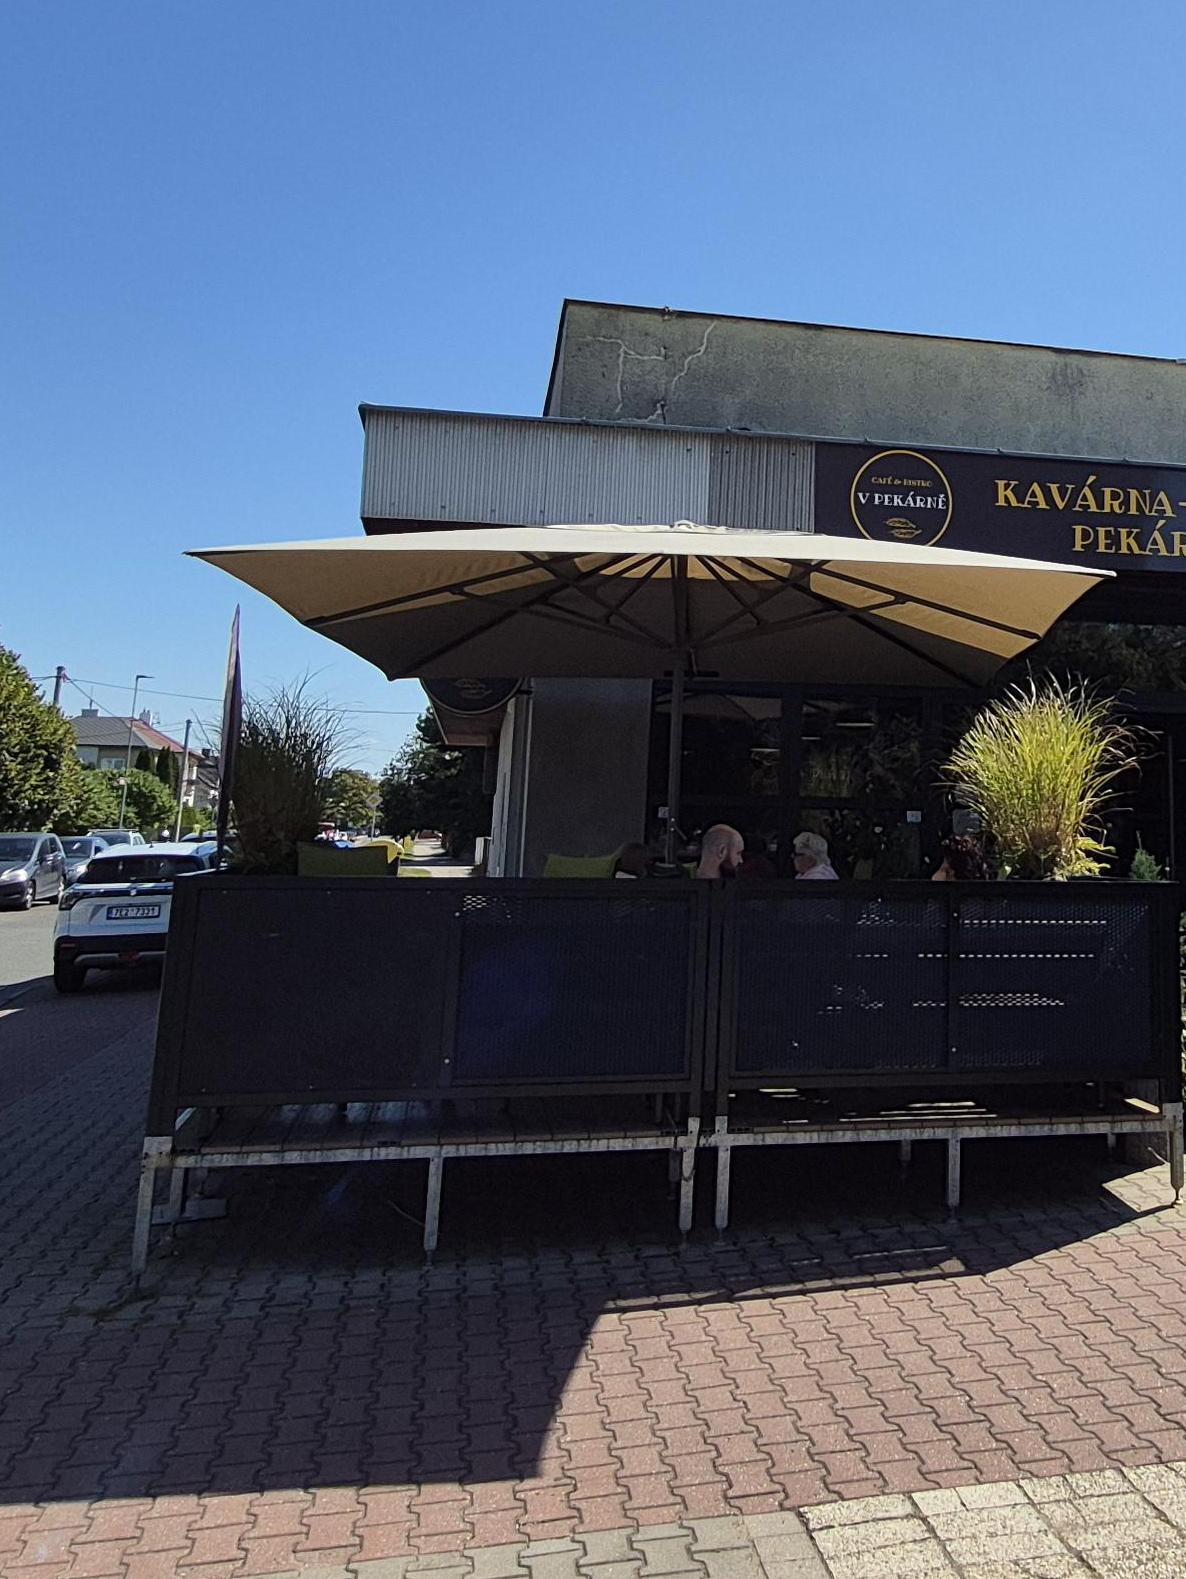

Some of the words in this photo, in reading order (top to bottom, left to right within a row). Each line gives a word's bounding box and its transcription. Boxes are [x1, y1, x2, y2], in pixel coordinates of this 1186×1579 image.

[871, 476, 893, 485] CAFÉ
[903, 478, 933, 488] BISTRO
[857, 492, 870, 505] V
[873, 491, 947, 510] PEKÁRNĚ
